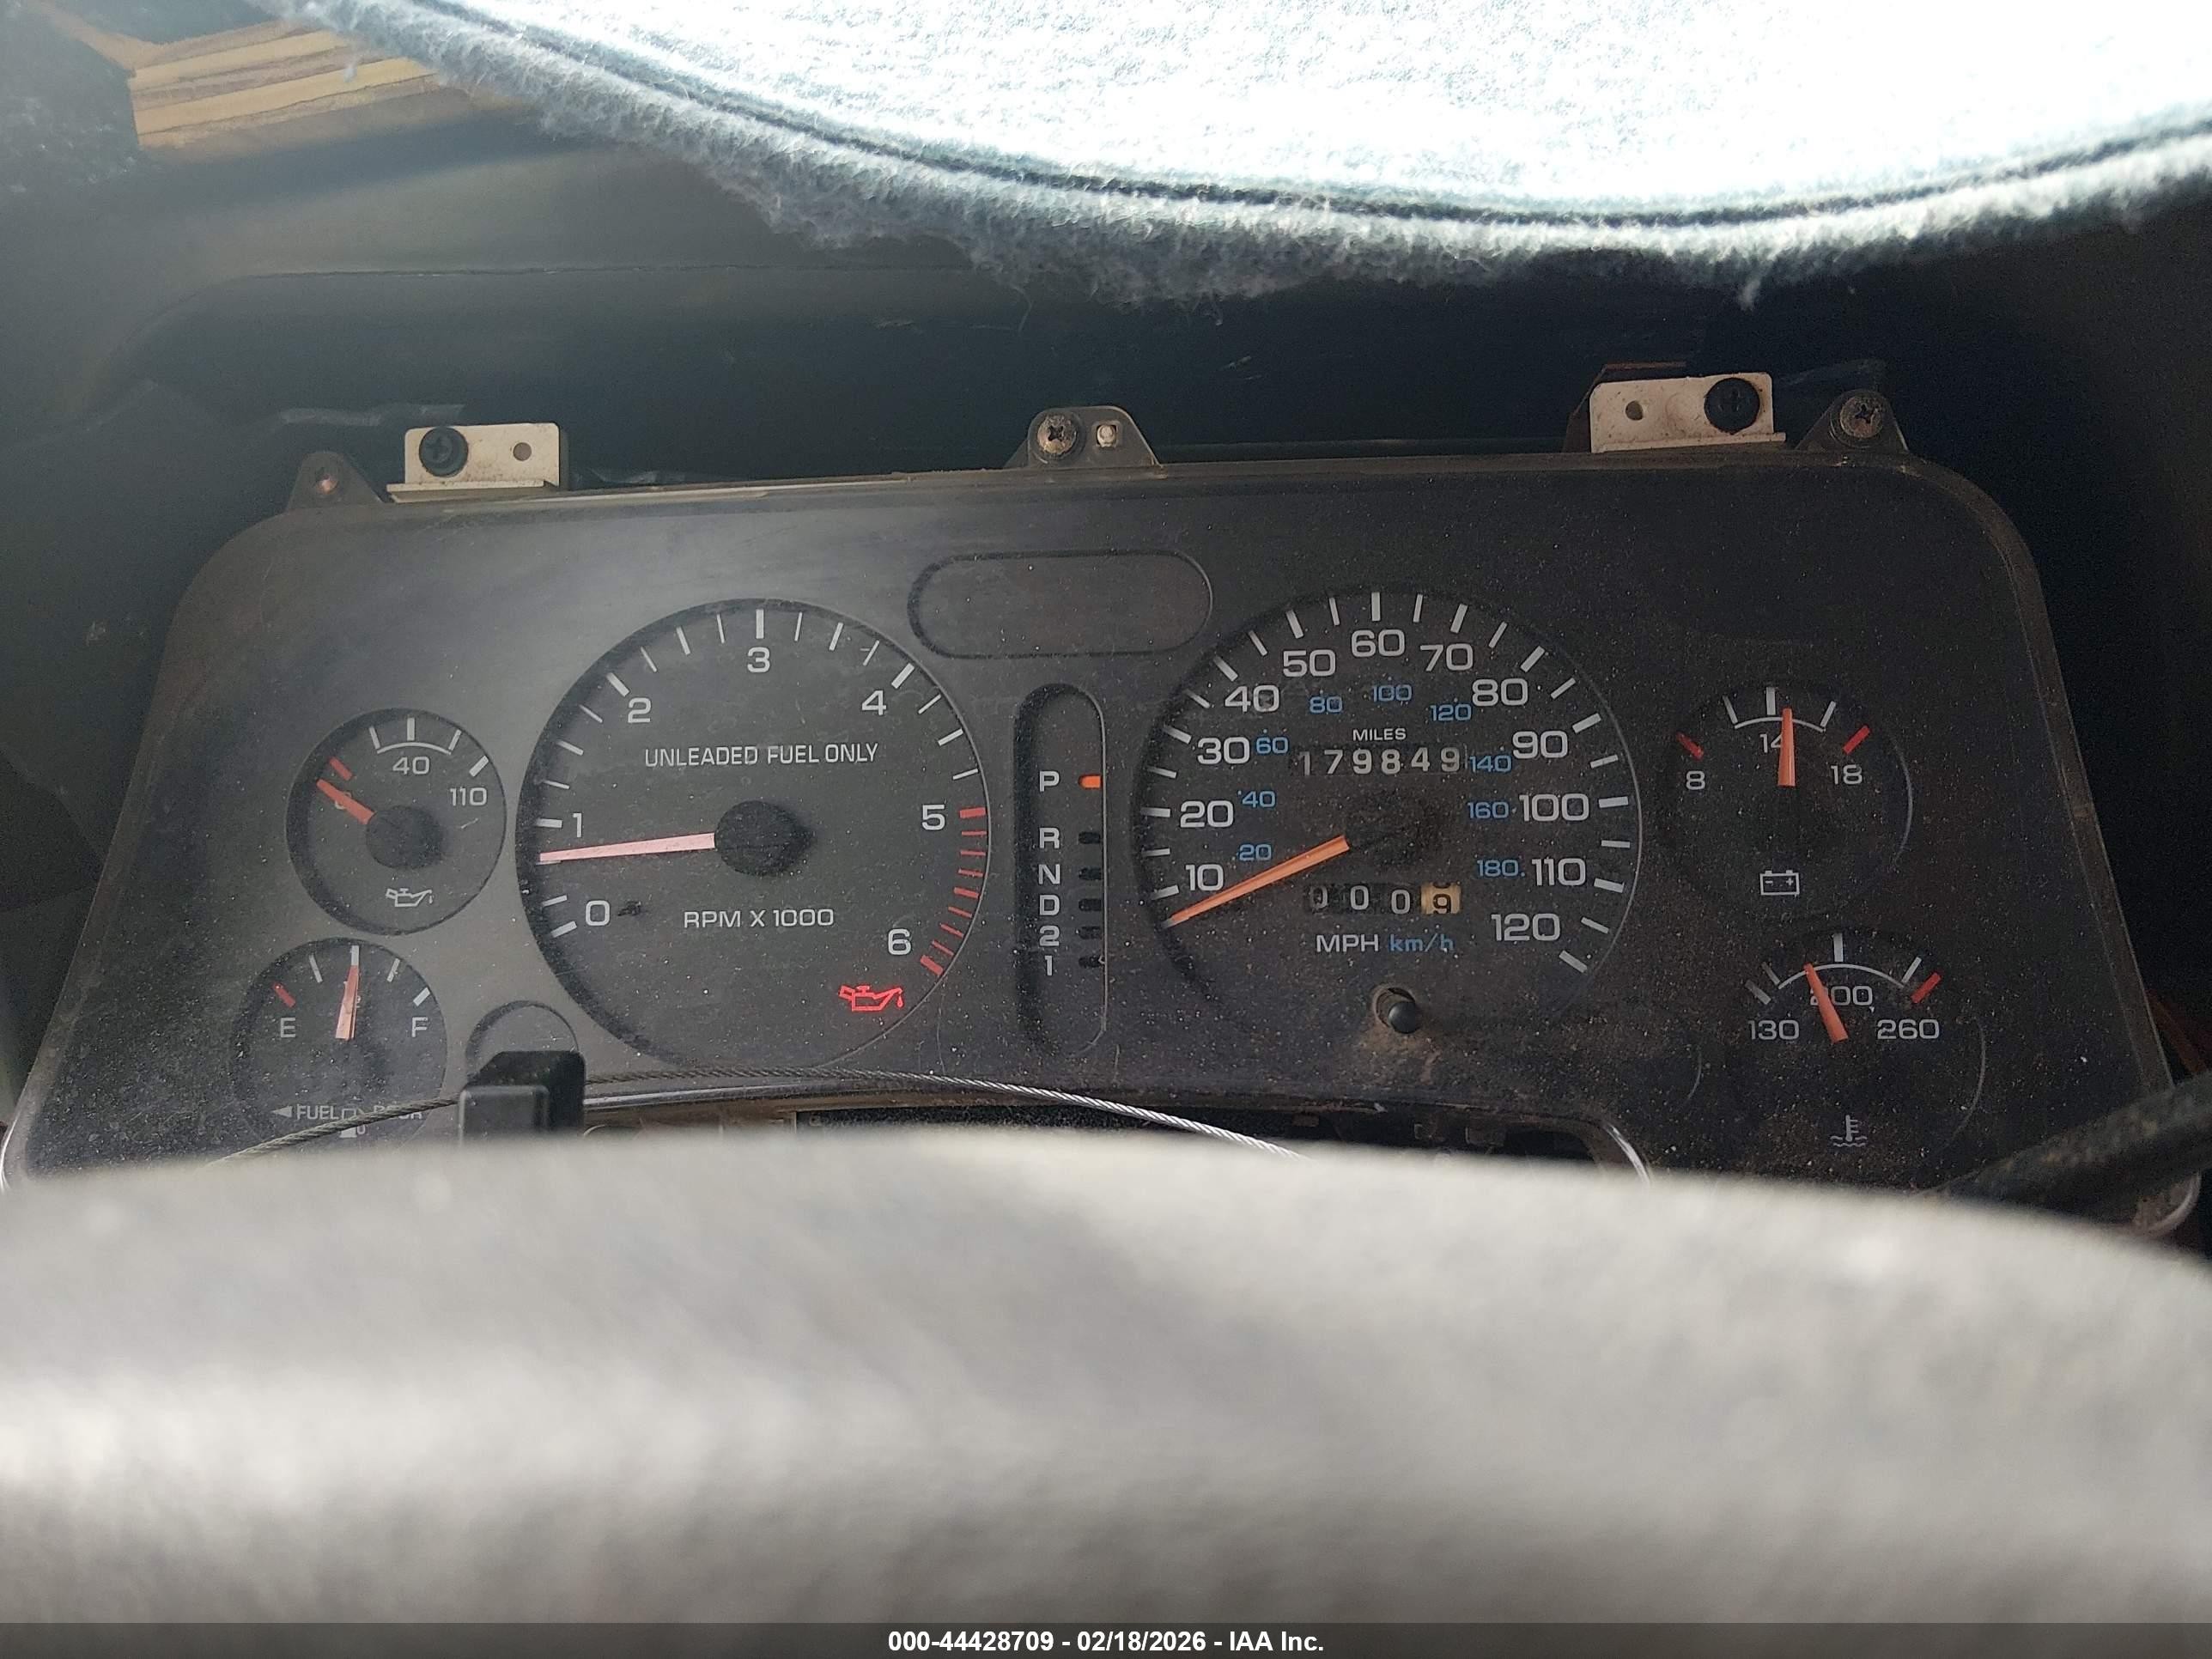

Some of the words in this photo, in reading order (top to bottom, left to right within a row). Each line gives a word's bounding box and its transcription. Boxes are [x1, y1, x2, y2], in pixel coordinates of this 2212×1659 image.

[1351, 629, 1407, 658] 60
[746, 646, 771, 673] 3
[1282, 648, 1337, 678] 50
[1419, 643, 1474, 672] 70
[861, 690, 887, 715] 4
[1225, 684, 1279, 713] 40
[1372, 684, 1413, 702] 100
[1472, 678, 1528, 707] 80
[626, 697, 652, 723] 2
[1309, 696, 1342, 714] 80
[1430, 703, 1472, 722] 120
[1352, 727, 1407, 742] MILES
[1512, 730, 1569, 759] 90
[644, 745, 757, 767] UNLEADED
[767, 744, 822, 764] FUEL
[825, 743, 878, 763] ONLY
[1197, 736, 1250, 765] 30
[1255, 737, 1289, 754] 60
[392, 757, 430, 775] 40
[1299, 747, 1461, 776] 179849
[1469, 755, 1511, 772] 140
[1039, 771, 1060, 791] P
[1686, 771, 1705, 790] 8
[1831, 764, 1863, 785] 18
[450, 787, 487, 805] 110
[1240, 790, 1276, 808] 40
[921, 805, 946, 831] 5
[1180, 799, 1234, 828] 20
[1468, 802, 1509, 819] 160
[1518, 793, 1590, 822] 100
[571, 811, 585, 838] 1
[1039, 828, 1060, 848] R
[1237, 843, 1272, 860] 20
[1038, 864, 1060, 884] N
[1186, 864, 1224, 891] 10
[1476, 860, 1519, 877] 180
[1532, 858, 1587, 886] 110
[585, 901, 610, 927] 0
[1038, 895, 1060, 915] D
[684, 910, 740, 929] RPM
[750, 909, 764, 928] X
[774, 908, 834, 927] 1000
[1491, 913, 1561, 942] 120
[887, 929, 912, 956] 6
[1040, 926, 1060, 945] 2
[1316, 934, 1379, 952] MPH
[1389, 933, 1454, 952] km/h
[1044, 955, 1054, 975] 1
[280, 1018, 296, 1038] E
[411, 1017, 428, 1037] F
[1748, 1019, 1800, 1040] 130
[1877, 1019, 1939, 1040] 260
[298, 1106, 338, 1120] FUEL
